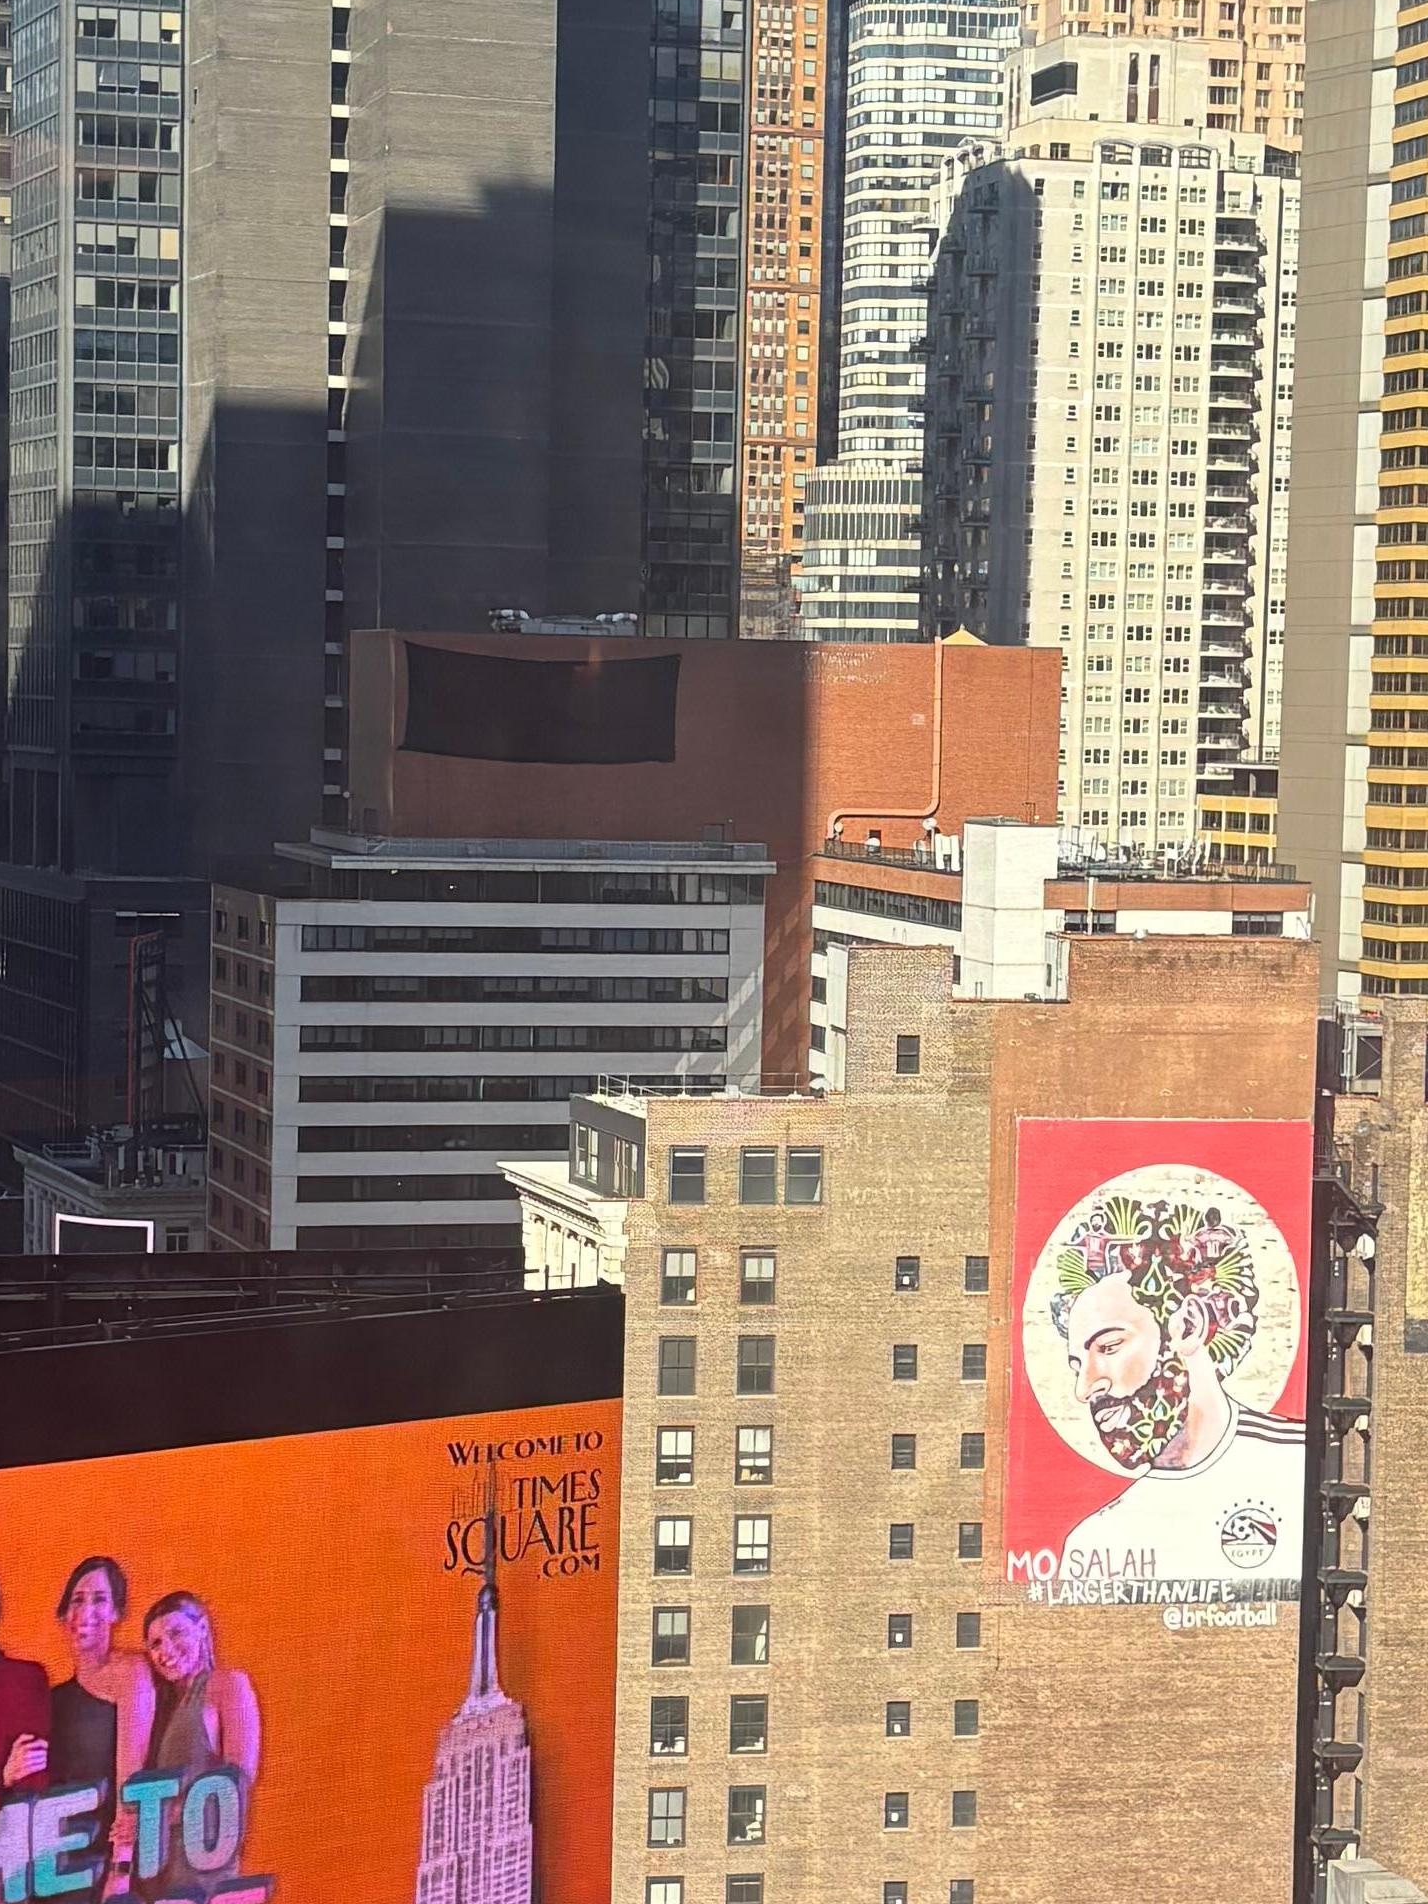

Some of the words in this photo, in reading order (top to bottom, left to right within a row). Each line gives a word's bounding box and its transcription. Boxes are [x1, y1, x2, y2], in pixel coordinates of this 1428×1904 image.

[513, 1468, 603, 1509] TIMES
[444, 1503, 600, 1577] SQUARE
[536, 1554, 600, 1580] .COM
[1006, 1548, 1058, 1582] MO
[1069, 1548, 1157, 1579] SALAH
[1162, 1603, 1278, 1631] @brfootball
[123, 1773, 243, 1882] TO
